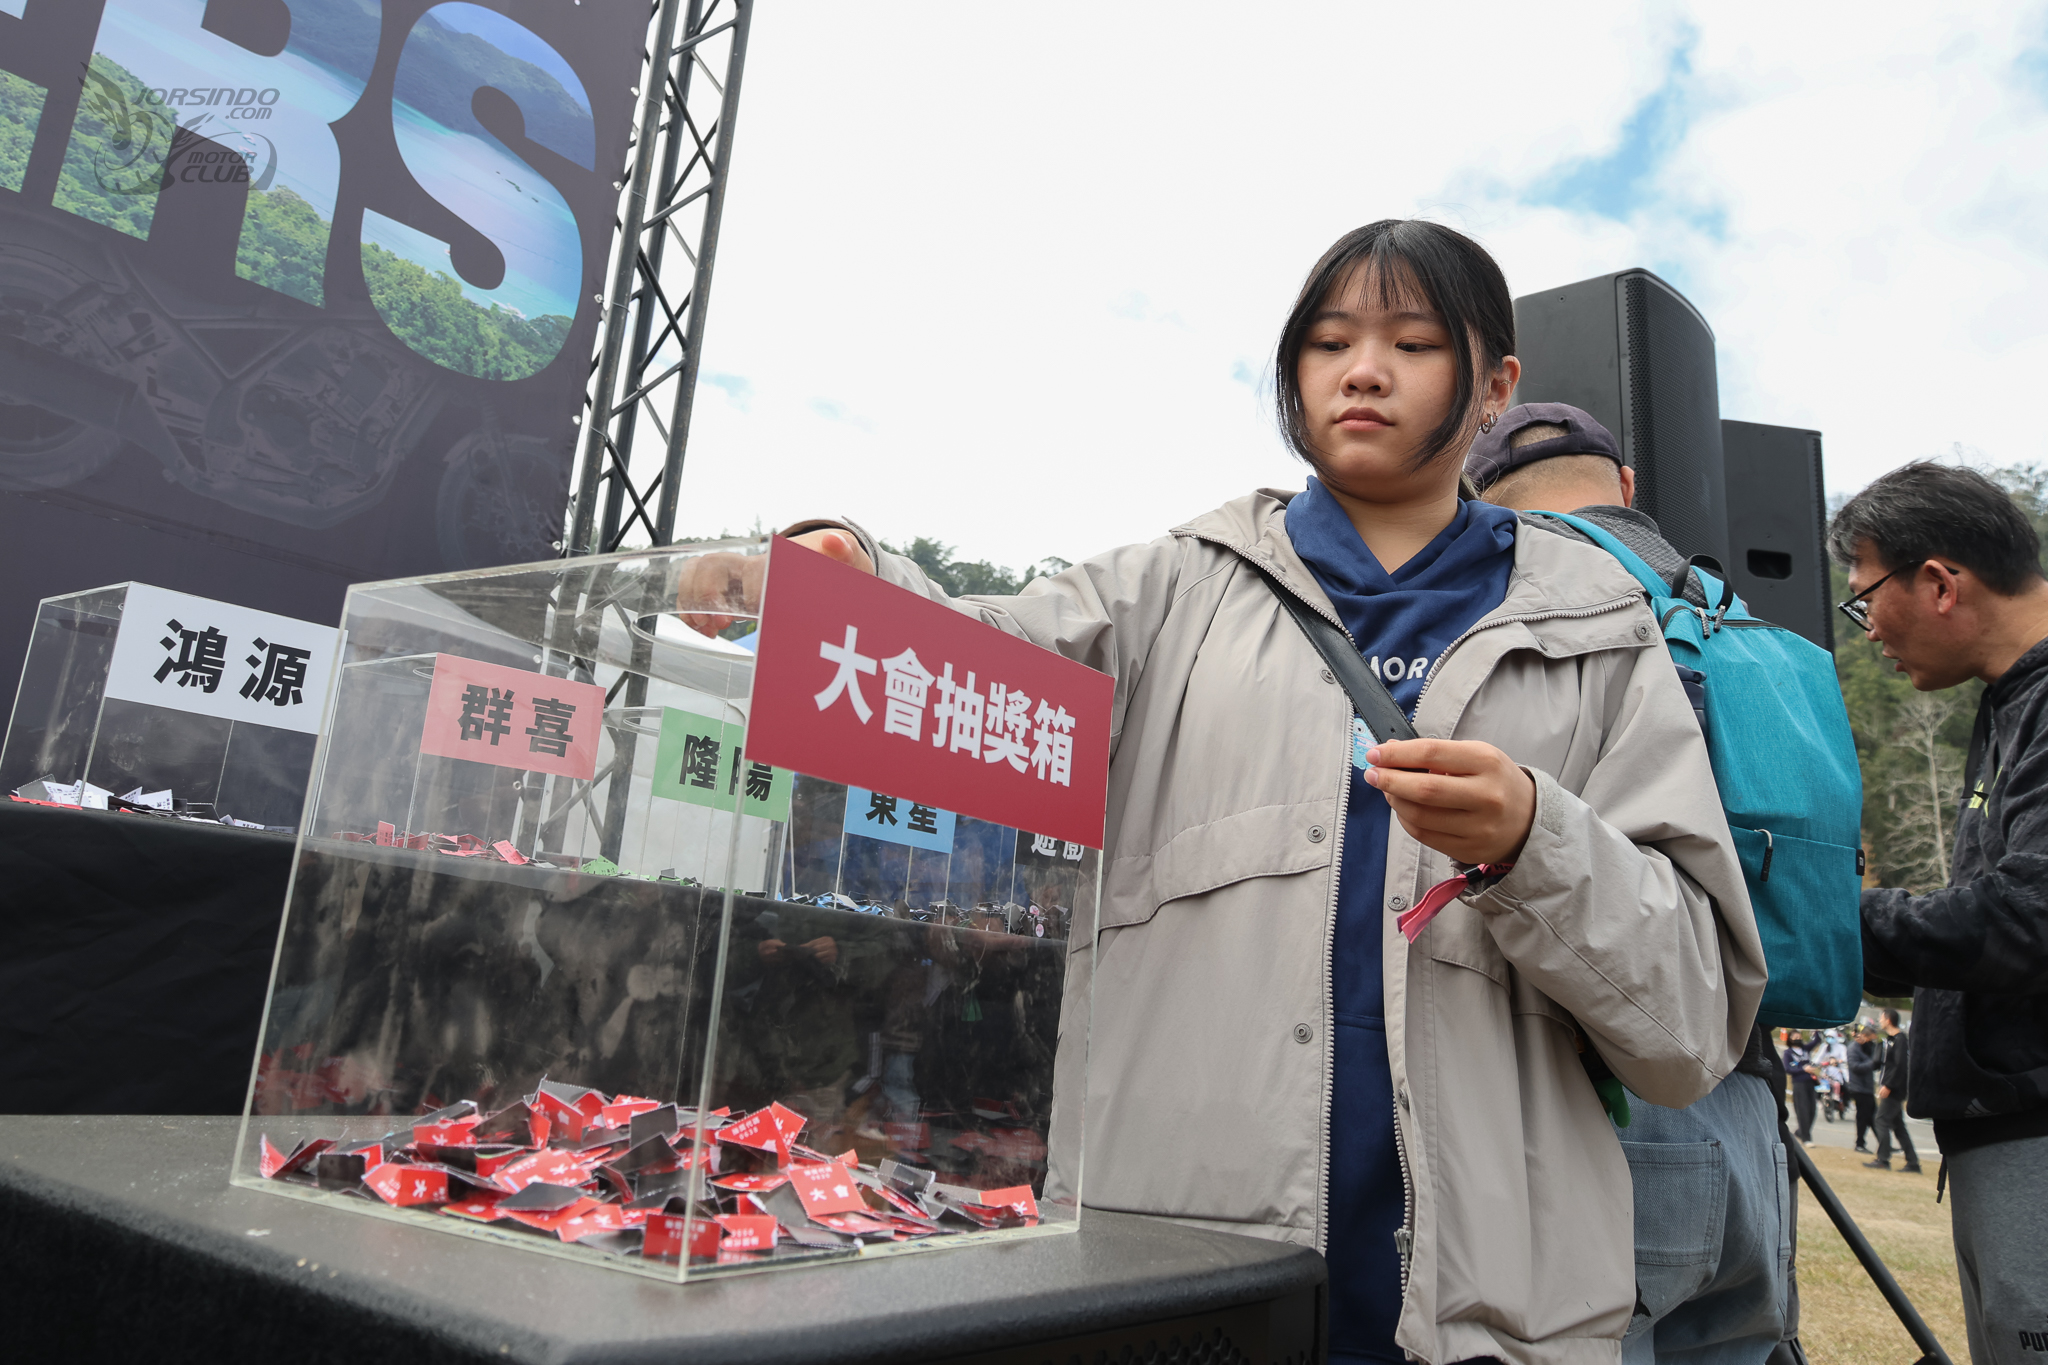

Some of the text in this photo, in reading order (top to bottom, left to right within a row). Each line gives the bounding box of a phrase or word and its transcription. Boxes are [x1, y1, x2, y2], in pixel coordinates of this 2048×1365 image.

[153, 618, 312, 707] 鴻源
[813, 624, 1076, 788] 大會抽獎箱
[457, 683, 577, 758] 群喜
